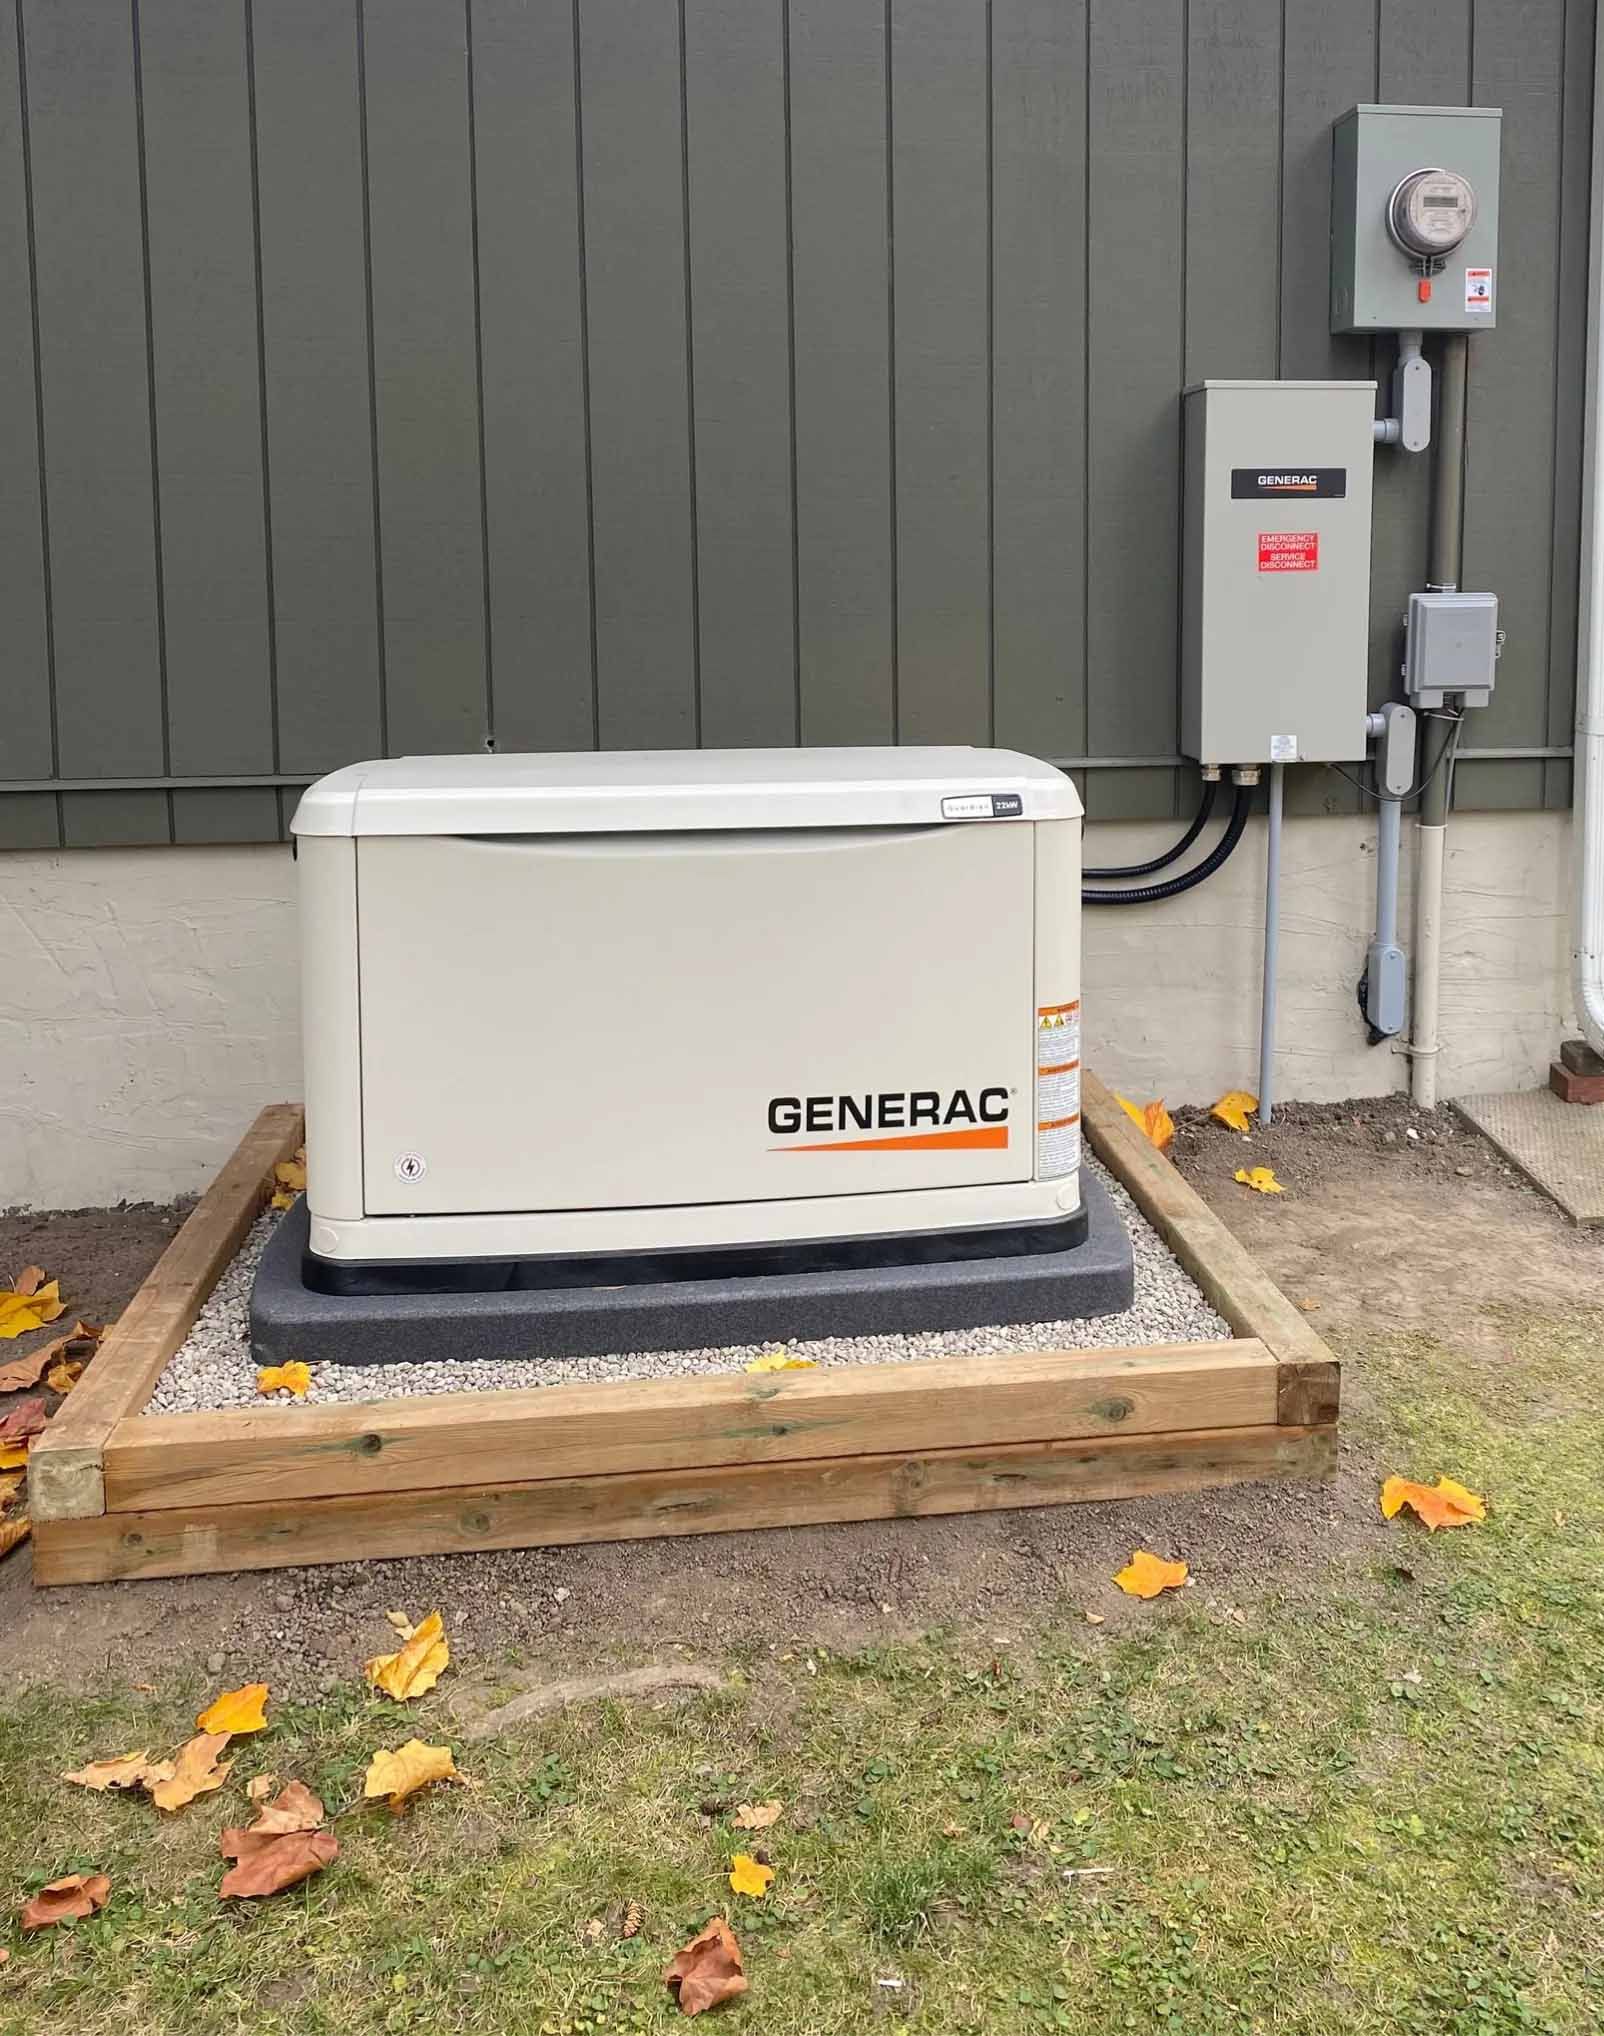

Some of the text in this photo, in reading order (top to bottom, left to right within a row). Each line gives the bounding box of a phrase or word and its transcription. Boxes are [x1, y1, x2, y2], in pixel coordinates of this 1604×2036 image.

[1257, 475, 1318, 486] GENERAC
[1261, 534, 1314, 543] EMERGENCY
[1260, 542, 1316, 551] DISCONNECT
[1270, 552, 1306, 561] SERVICE
[1260, 560, 1316, 569] DISCONNECT
[768, 1087, 1009, 1134] GENERAC
